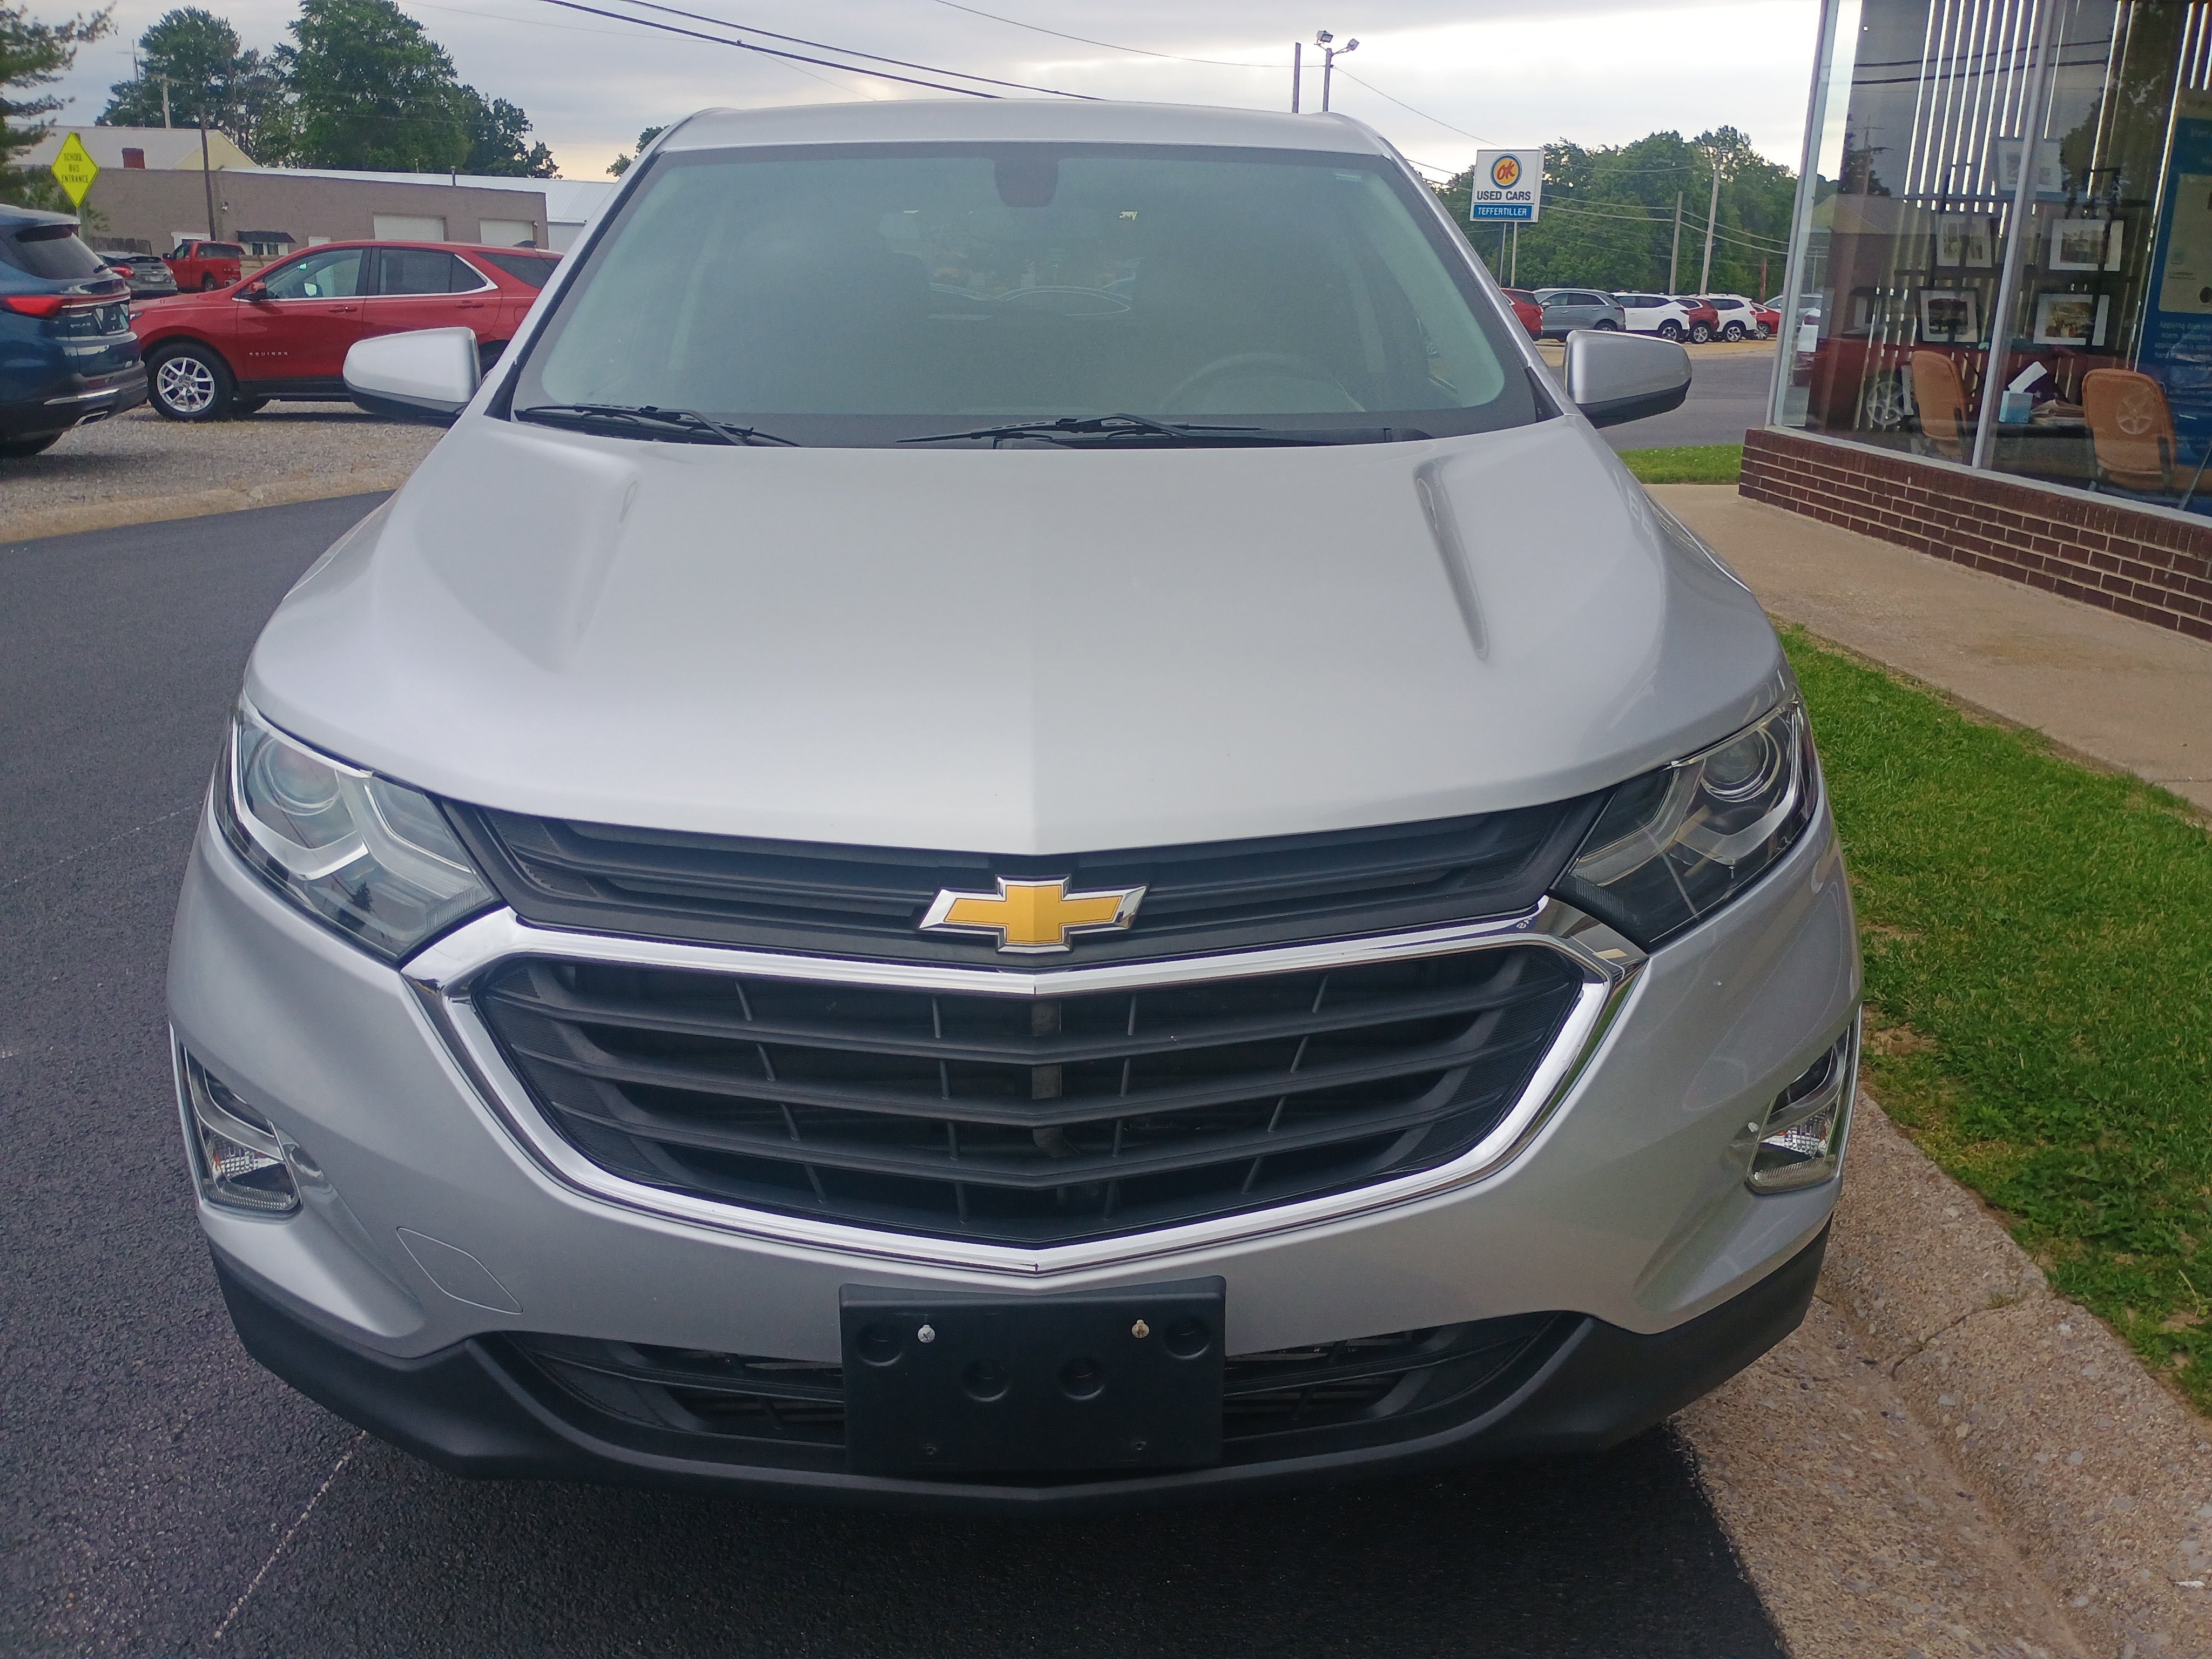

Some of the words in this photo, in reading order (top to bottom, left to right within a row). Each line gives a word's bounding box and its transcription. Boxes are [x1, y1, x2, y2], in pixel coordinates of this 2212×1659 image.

[64, 153, 83, 161] SCHOOL
[69, 164, 80, 172] BUS
[1496, 161, 1515, 180] OK
[61, 174, 89, 183] ENTRANCE
[1476, 191, 1502, 200] USED
[1505, 191, 1531, 200] CARS
[1478, 207, 1527, 216] TEFFERTILLER
